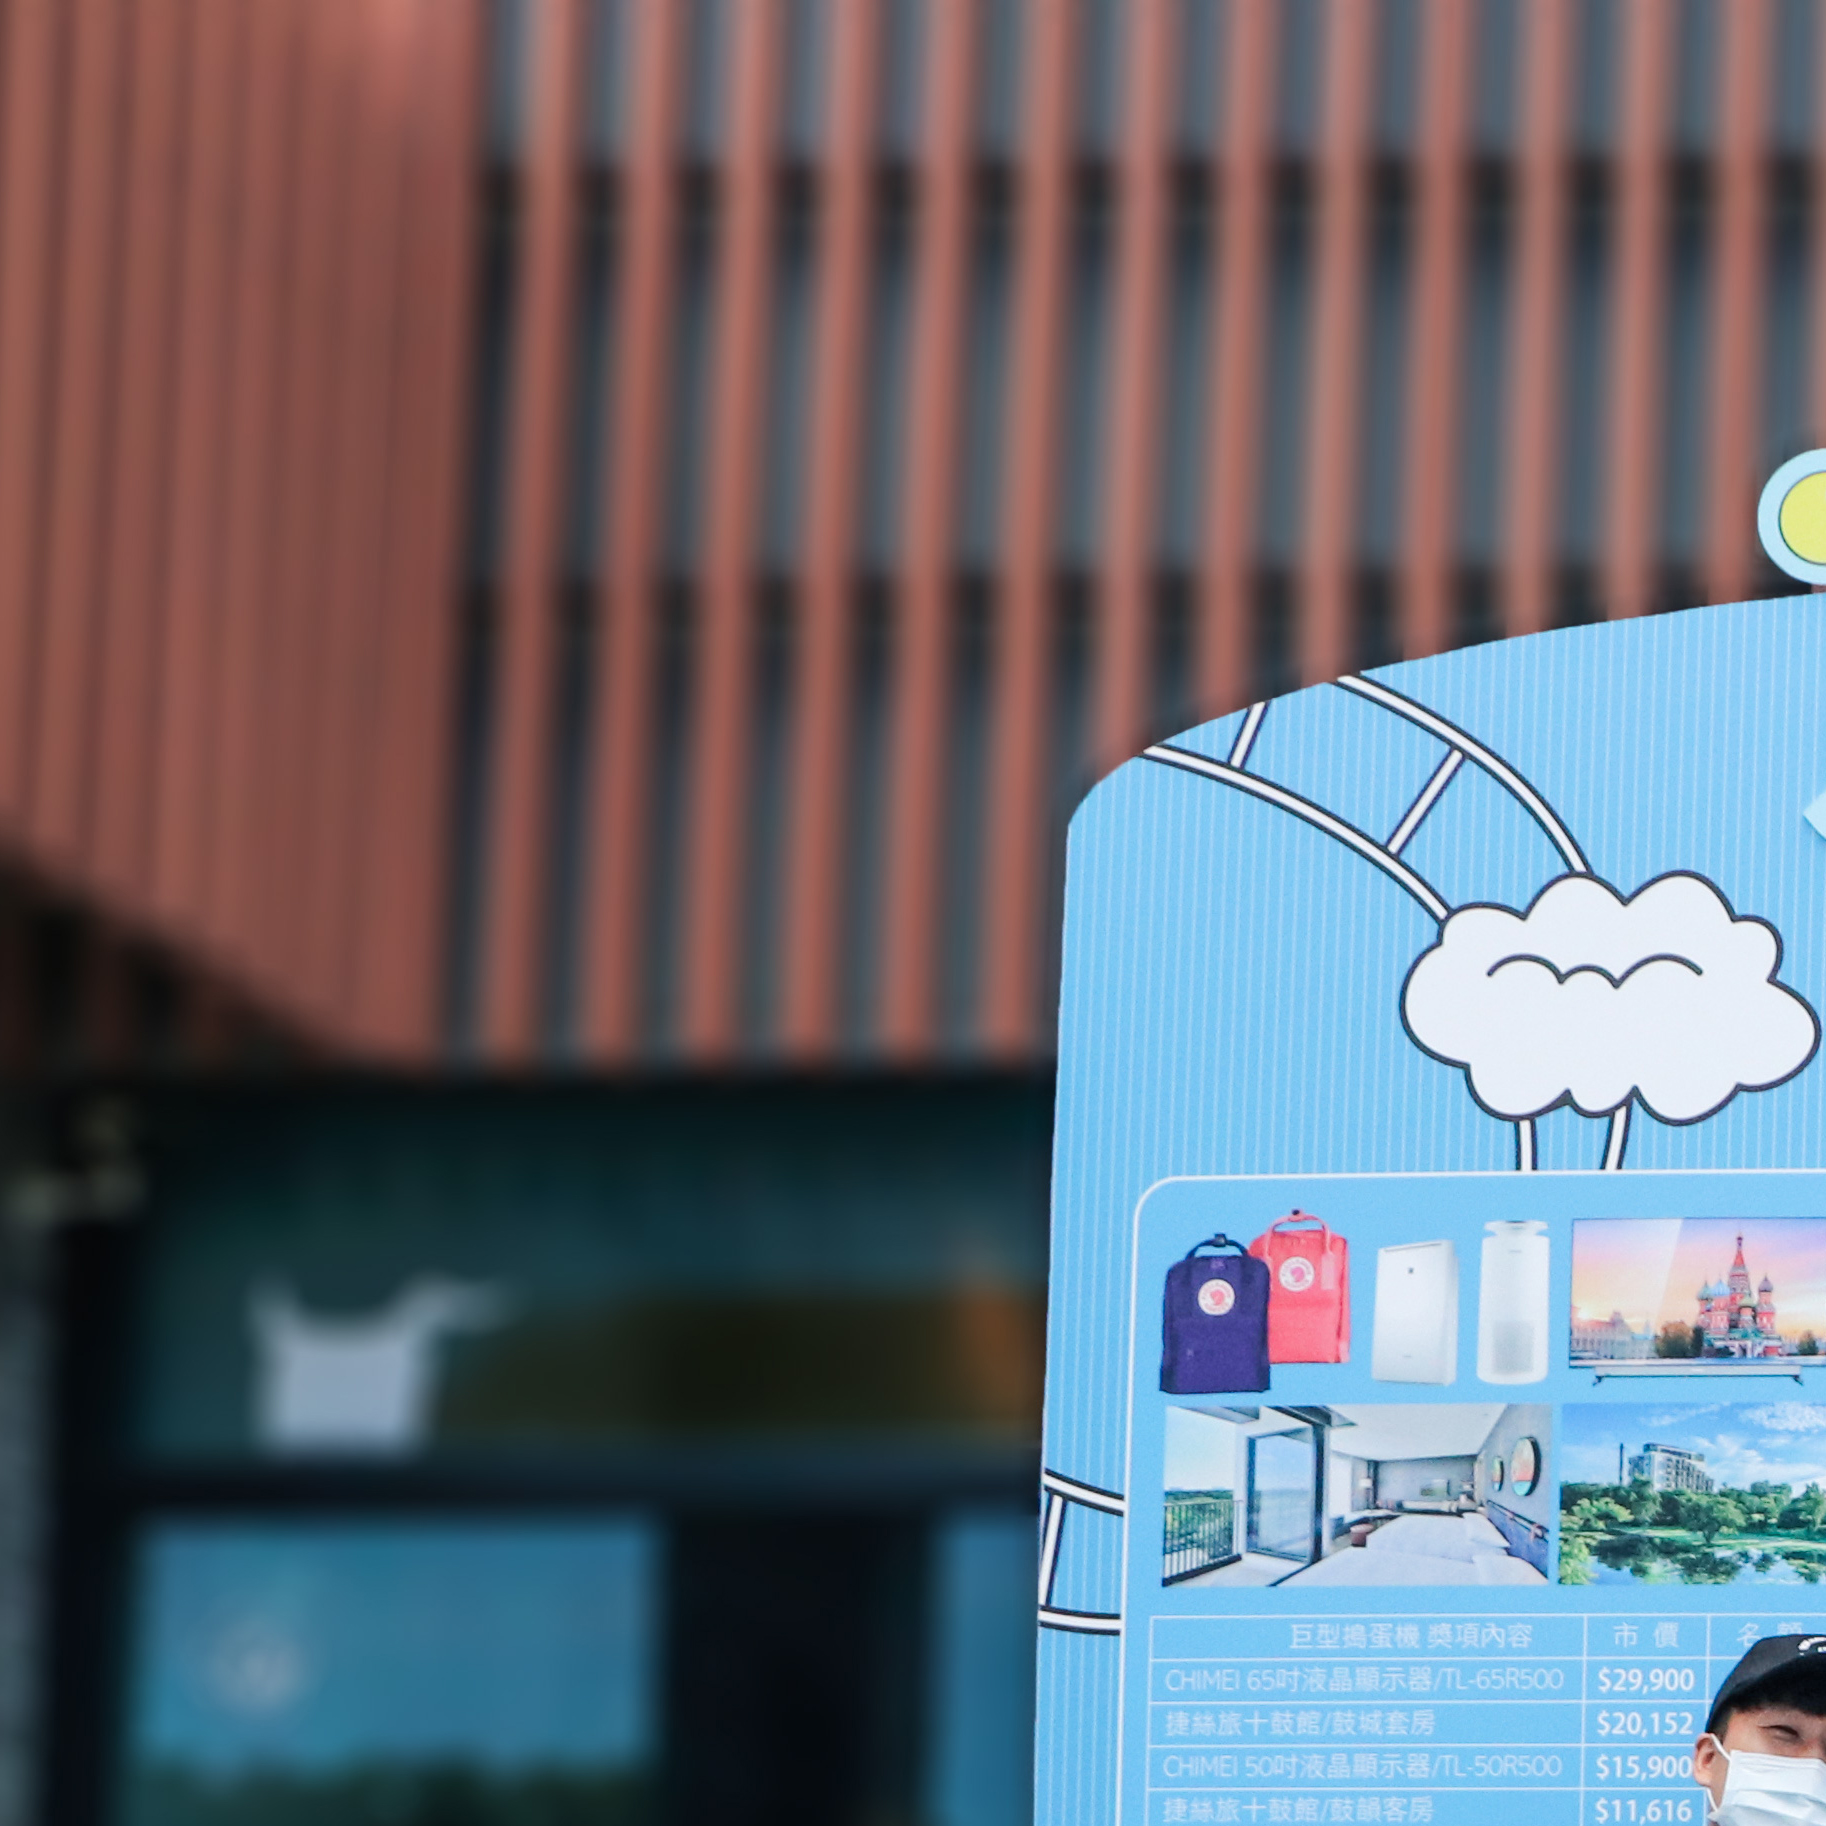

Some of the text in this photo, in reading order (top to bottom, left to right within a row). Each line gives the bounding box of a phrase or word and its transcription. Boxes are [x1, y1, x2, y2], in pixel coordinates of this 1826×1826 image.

[1165, 1668, 1240, 1692] CHIMEI
[1598, 1667, 1696, 1695] $29,900
[1597, 1710, 1694, 1738] $20,152
[1163, 1754, 1238, 1778] CHIMEI
[1596, 1754, 1692, 1782] $15,900
[1595, 1797, 1692, 1825] $11,616
